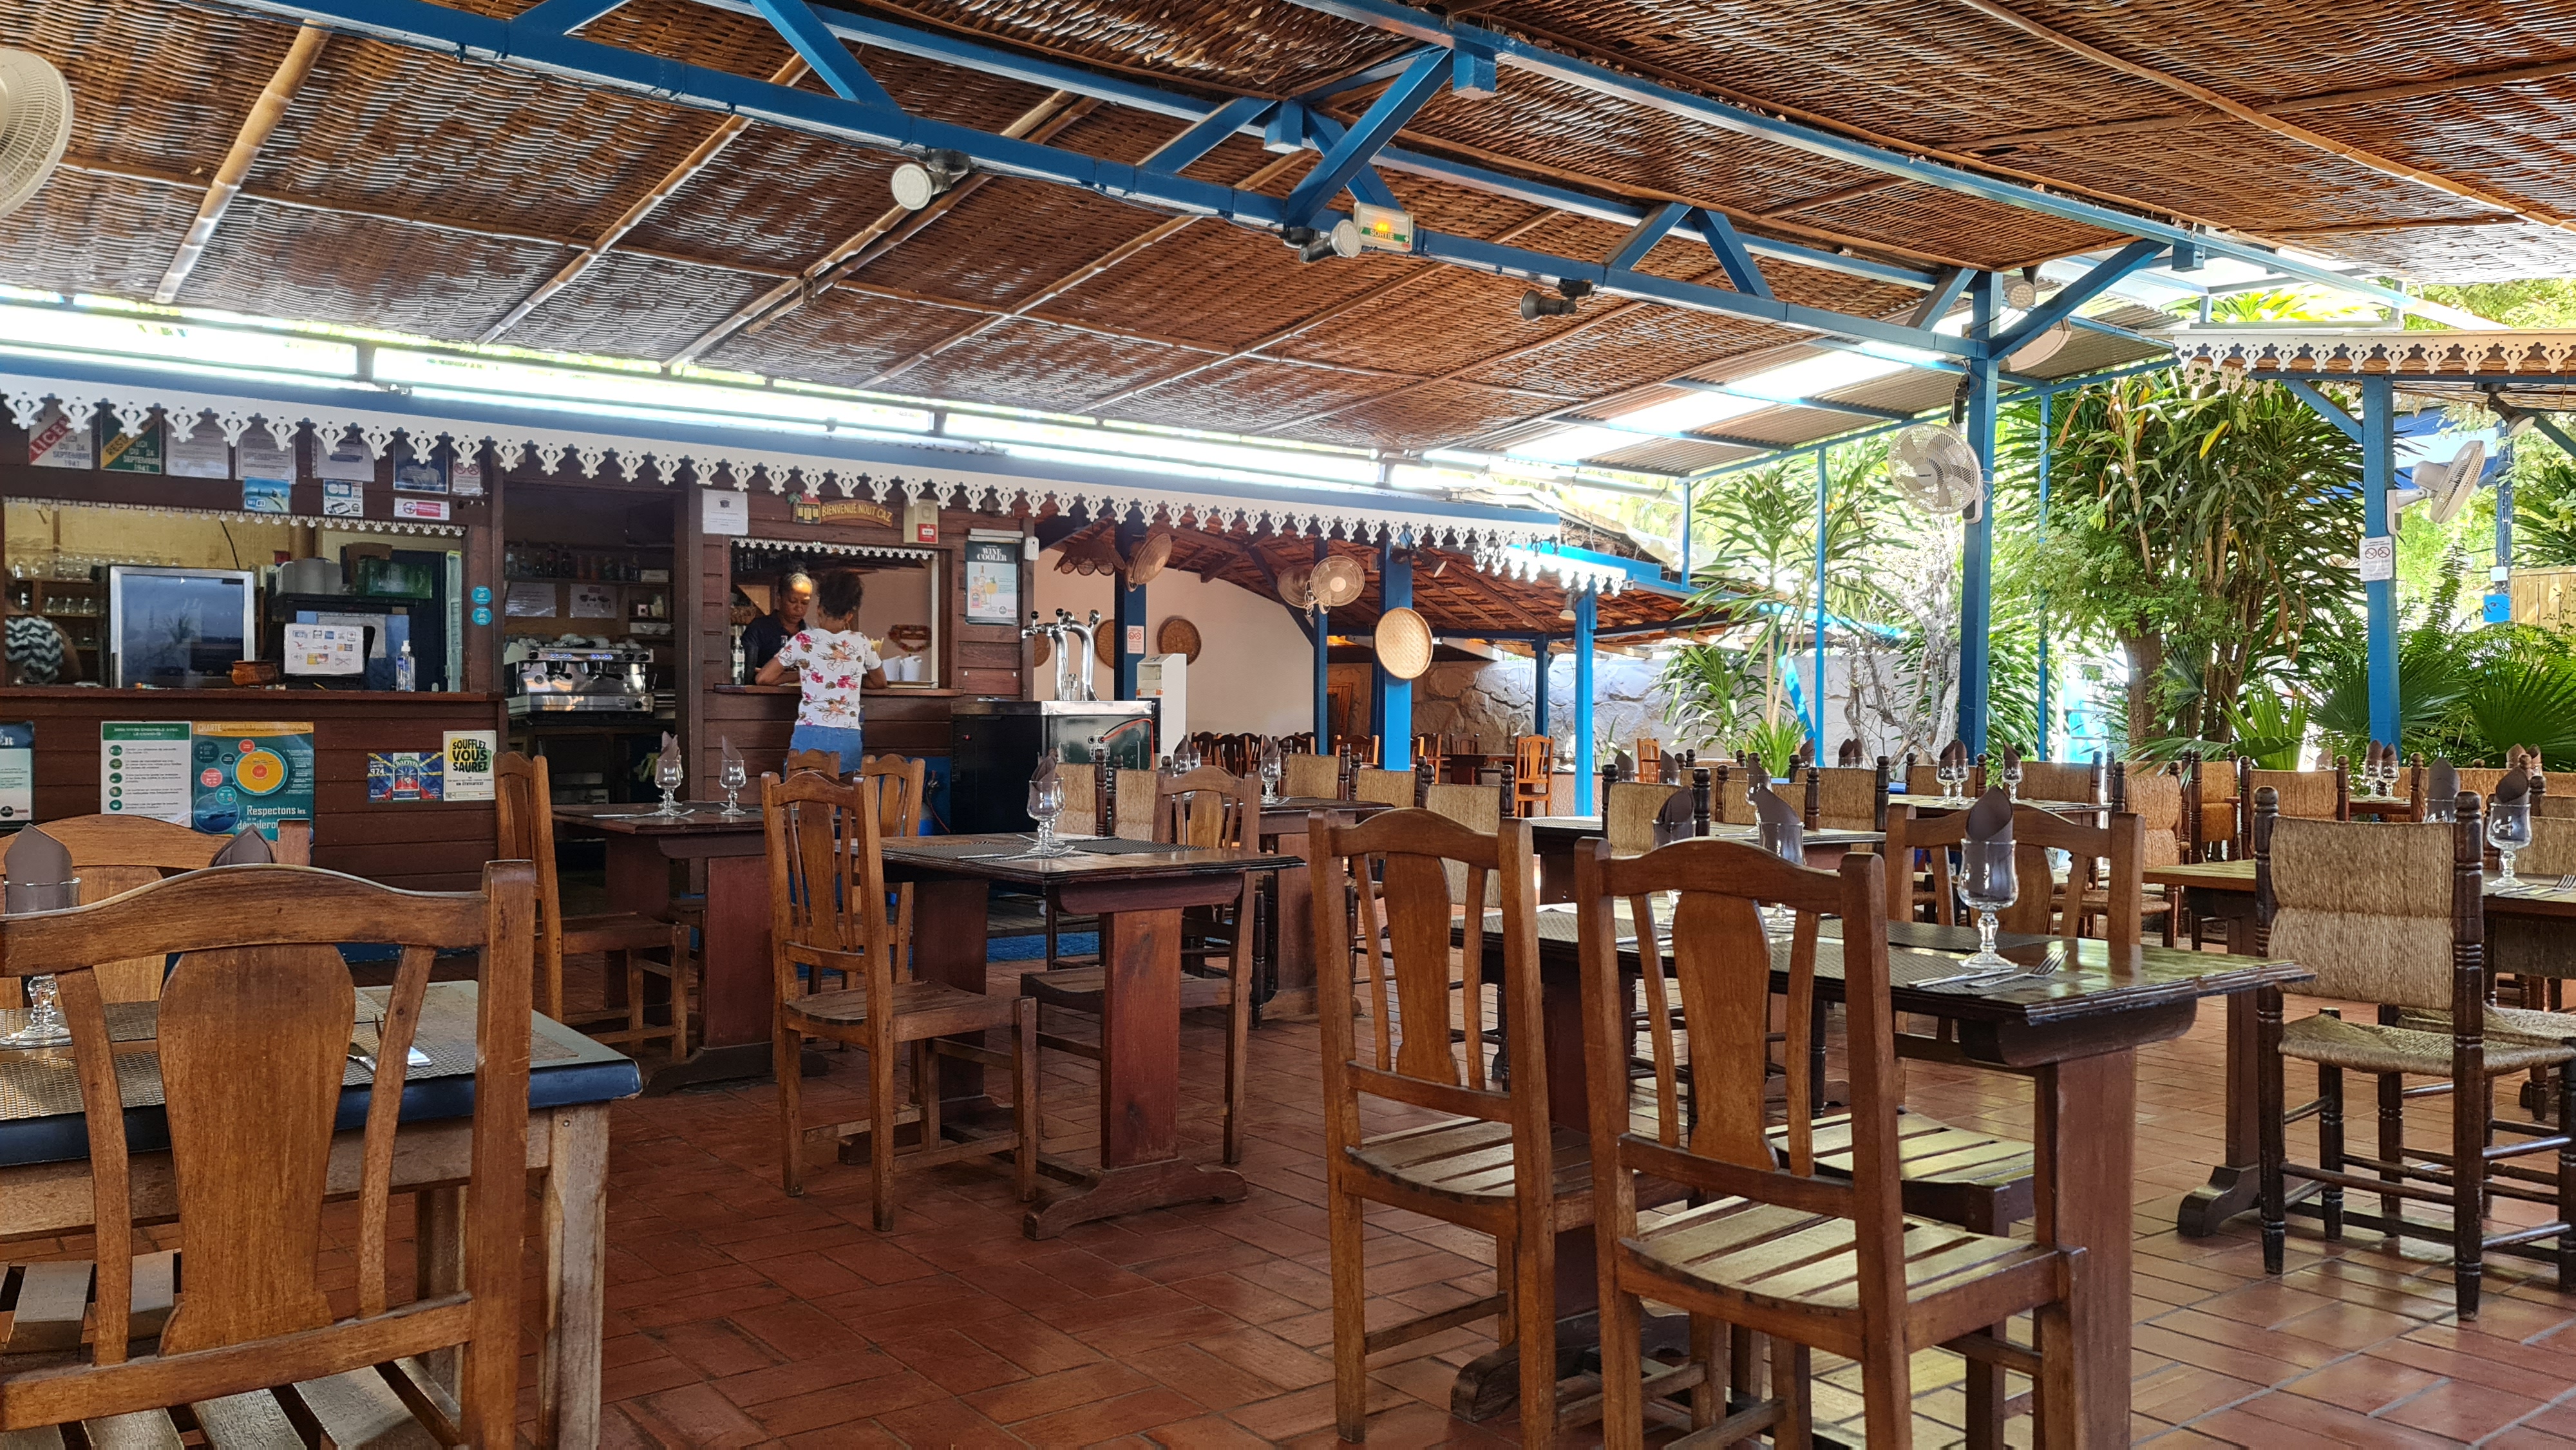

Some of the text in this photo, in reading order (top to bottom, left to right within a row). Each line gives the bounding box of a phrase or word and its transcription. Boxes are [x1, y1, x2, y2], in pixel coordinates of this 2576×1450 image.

[1370, 229, 1394, 240] SORTIE
[822, 503, 892, 522] BIENVENUE NOUT CAZ
[977, 553, 1007, 561] COOLER
[452, 739, 486, 750] SOUFFLEZ
[452, 749, 488, 761] VOUS
[453, 761, 488, 773] SAUREZ
[247, 805, 296, 816] Respectons
